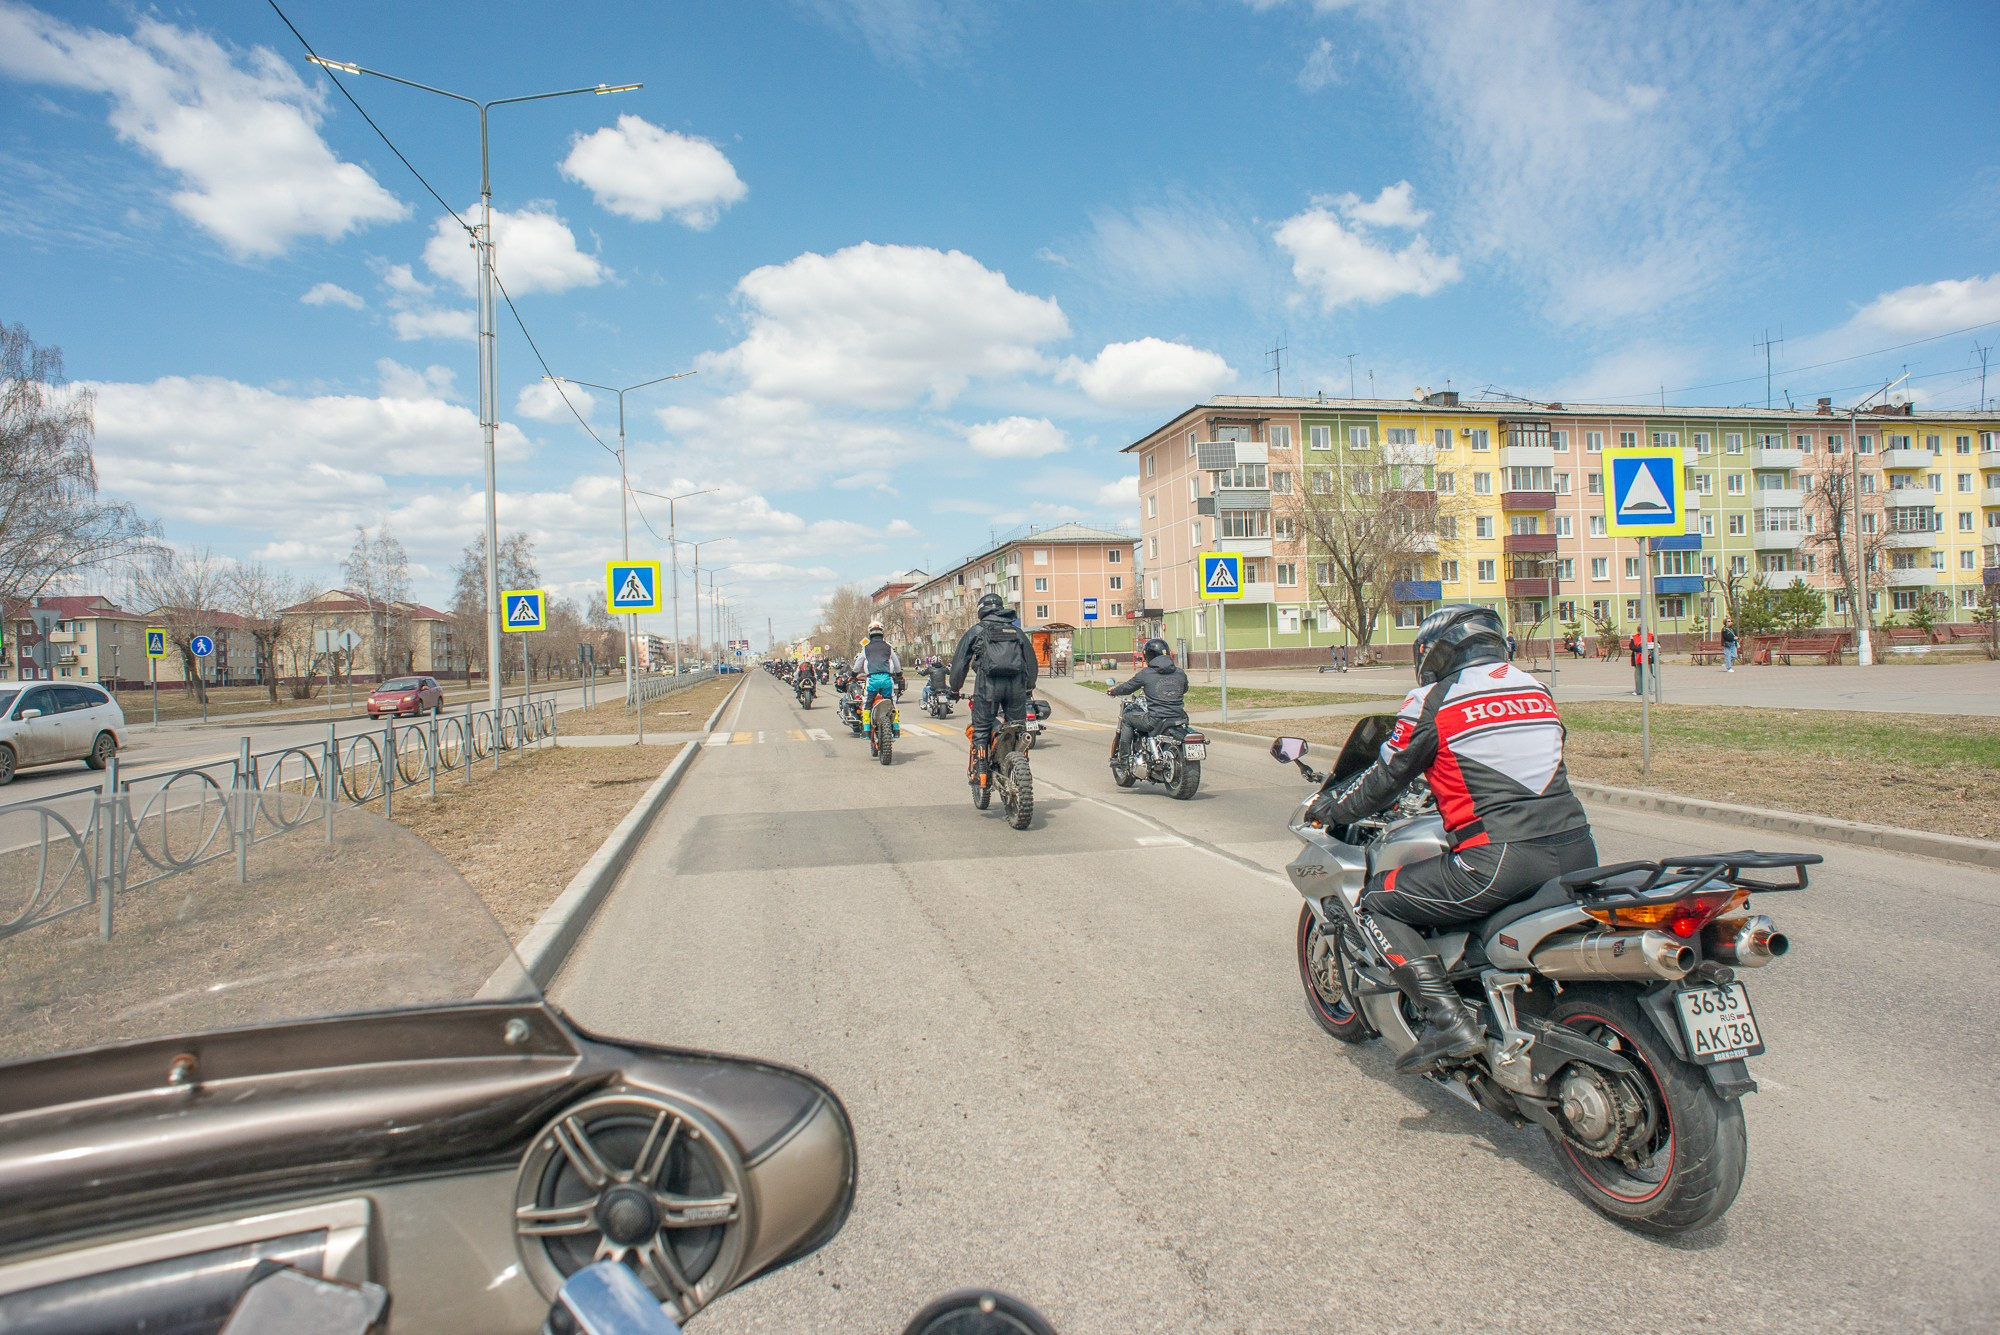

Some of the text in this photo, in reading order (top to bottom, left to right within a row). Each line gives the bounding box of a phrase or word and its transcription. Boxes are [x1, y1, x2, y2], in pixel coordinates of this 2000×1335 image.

[1461, 698, 1558, 723] HONDA
[1687, 989, 1738, 1015] 3635
[1719, 1013, 1736, 1022] RUS
[1728, 1022, 1754, 1045] 38
